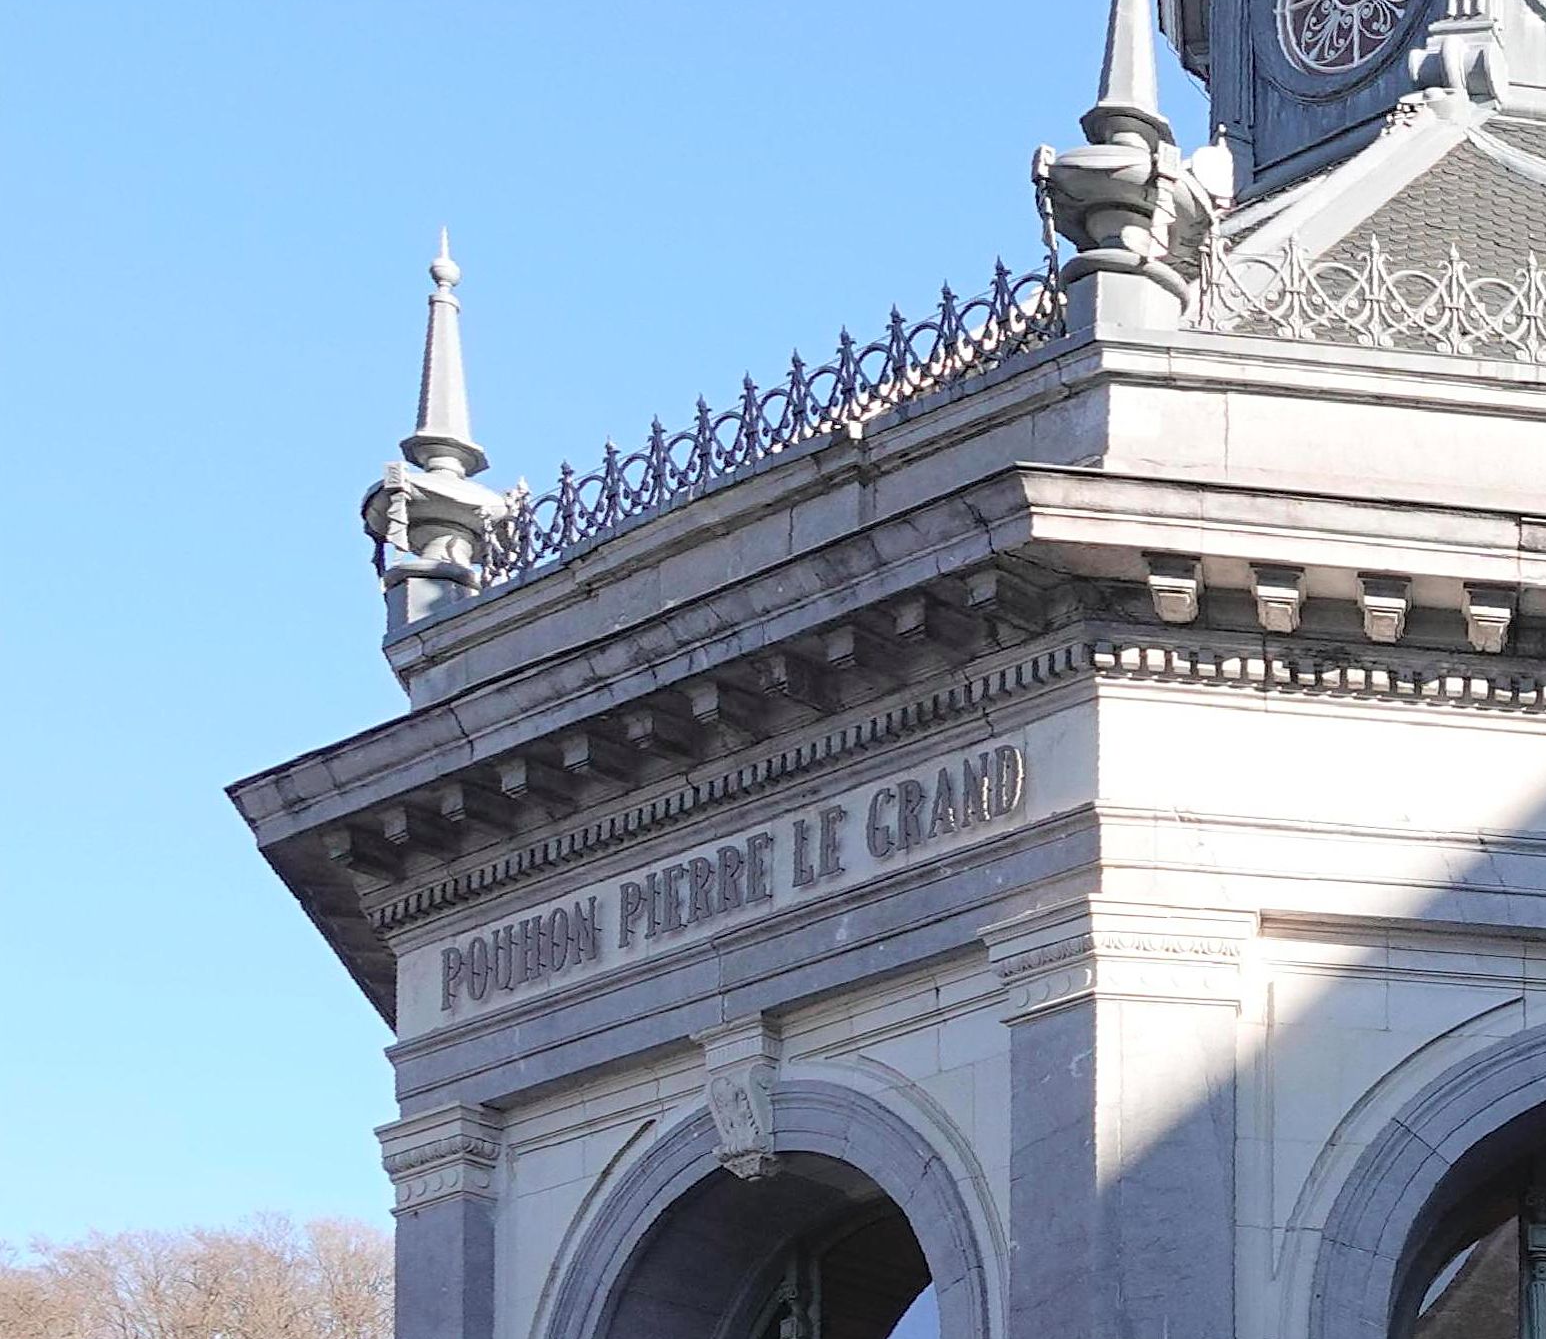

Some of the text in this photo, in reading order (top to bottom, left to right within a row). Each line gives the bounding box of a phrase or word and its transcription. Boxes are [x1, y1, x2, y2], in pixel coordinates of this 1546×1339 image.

[441, 744, 1025, 1012] POUHON PIERRE LE GRAND
